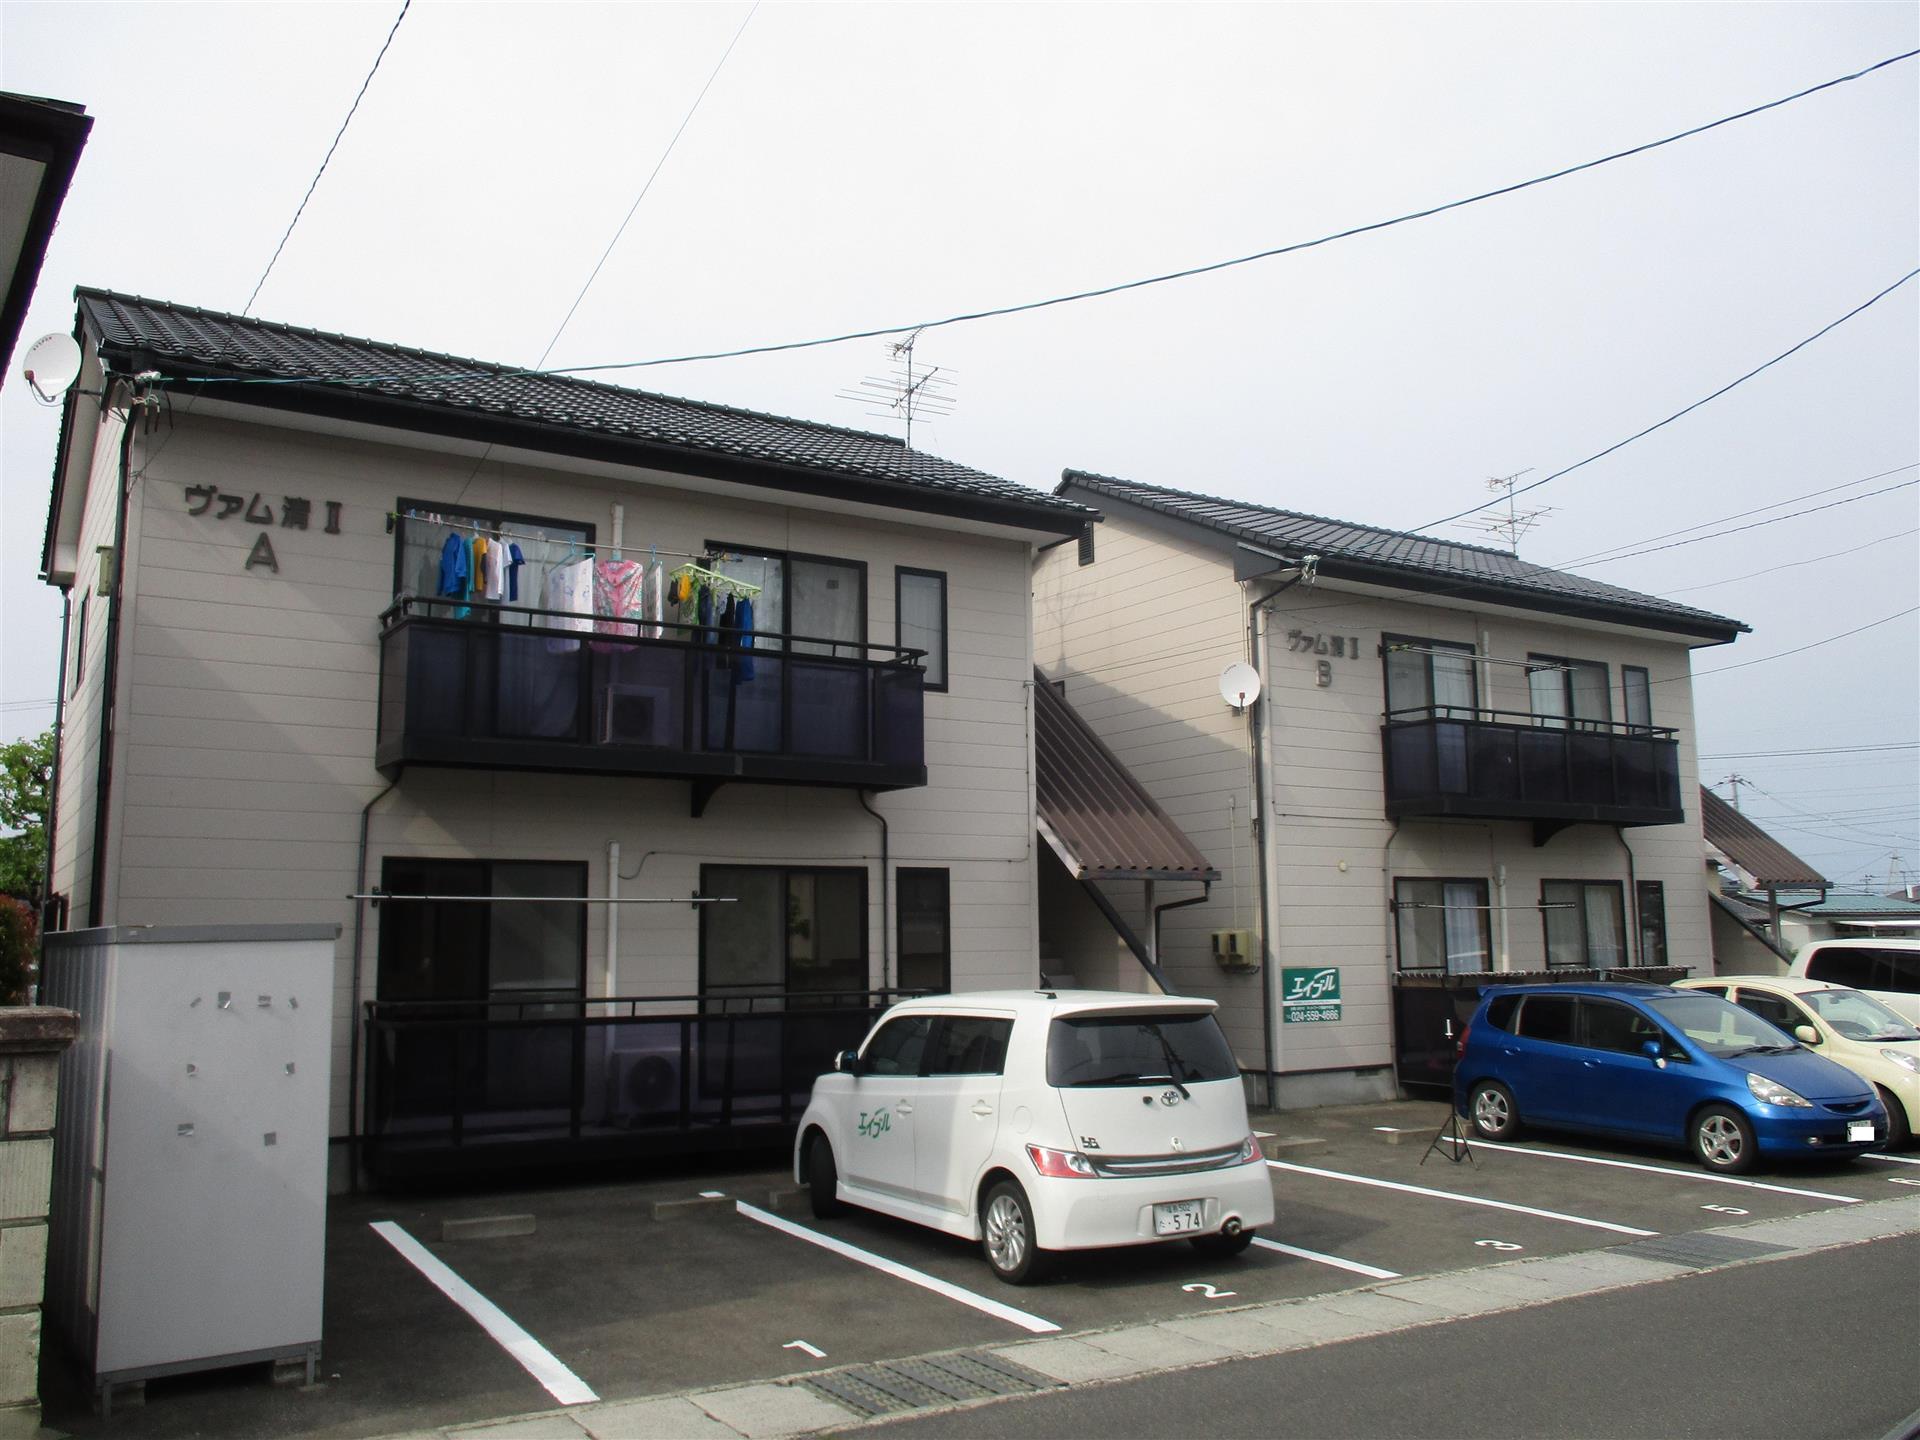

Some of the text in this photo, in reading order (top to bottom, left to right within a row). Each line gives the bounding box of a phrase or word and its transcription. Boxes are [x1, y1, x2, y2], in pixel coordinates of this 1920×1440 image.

[245, 532, 279, 573] A
[1316, 660, 1331, 687] B
[1700, 1204, 1750, 1215] 5
[1474, 1239, 1524, 1251] 3
[1181, 1283, 1238, 1298] 2
[782, 1340, 828, 1359] 1
